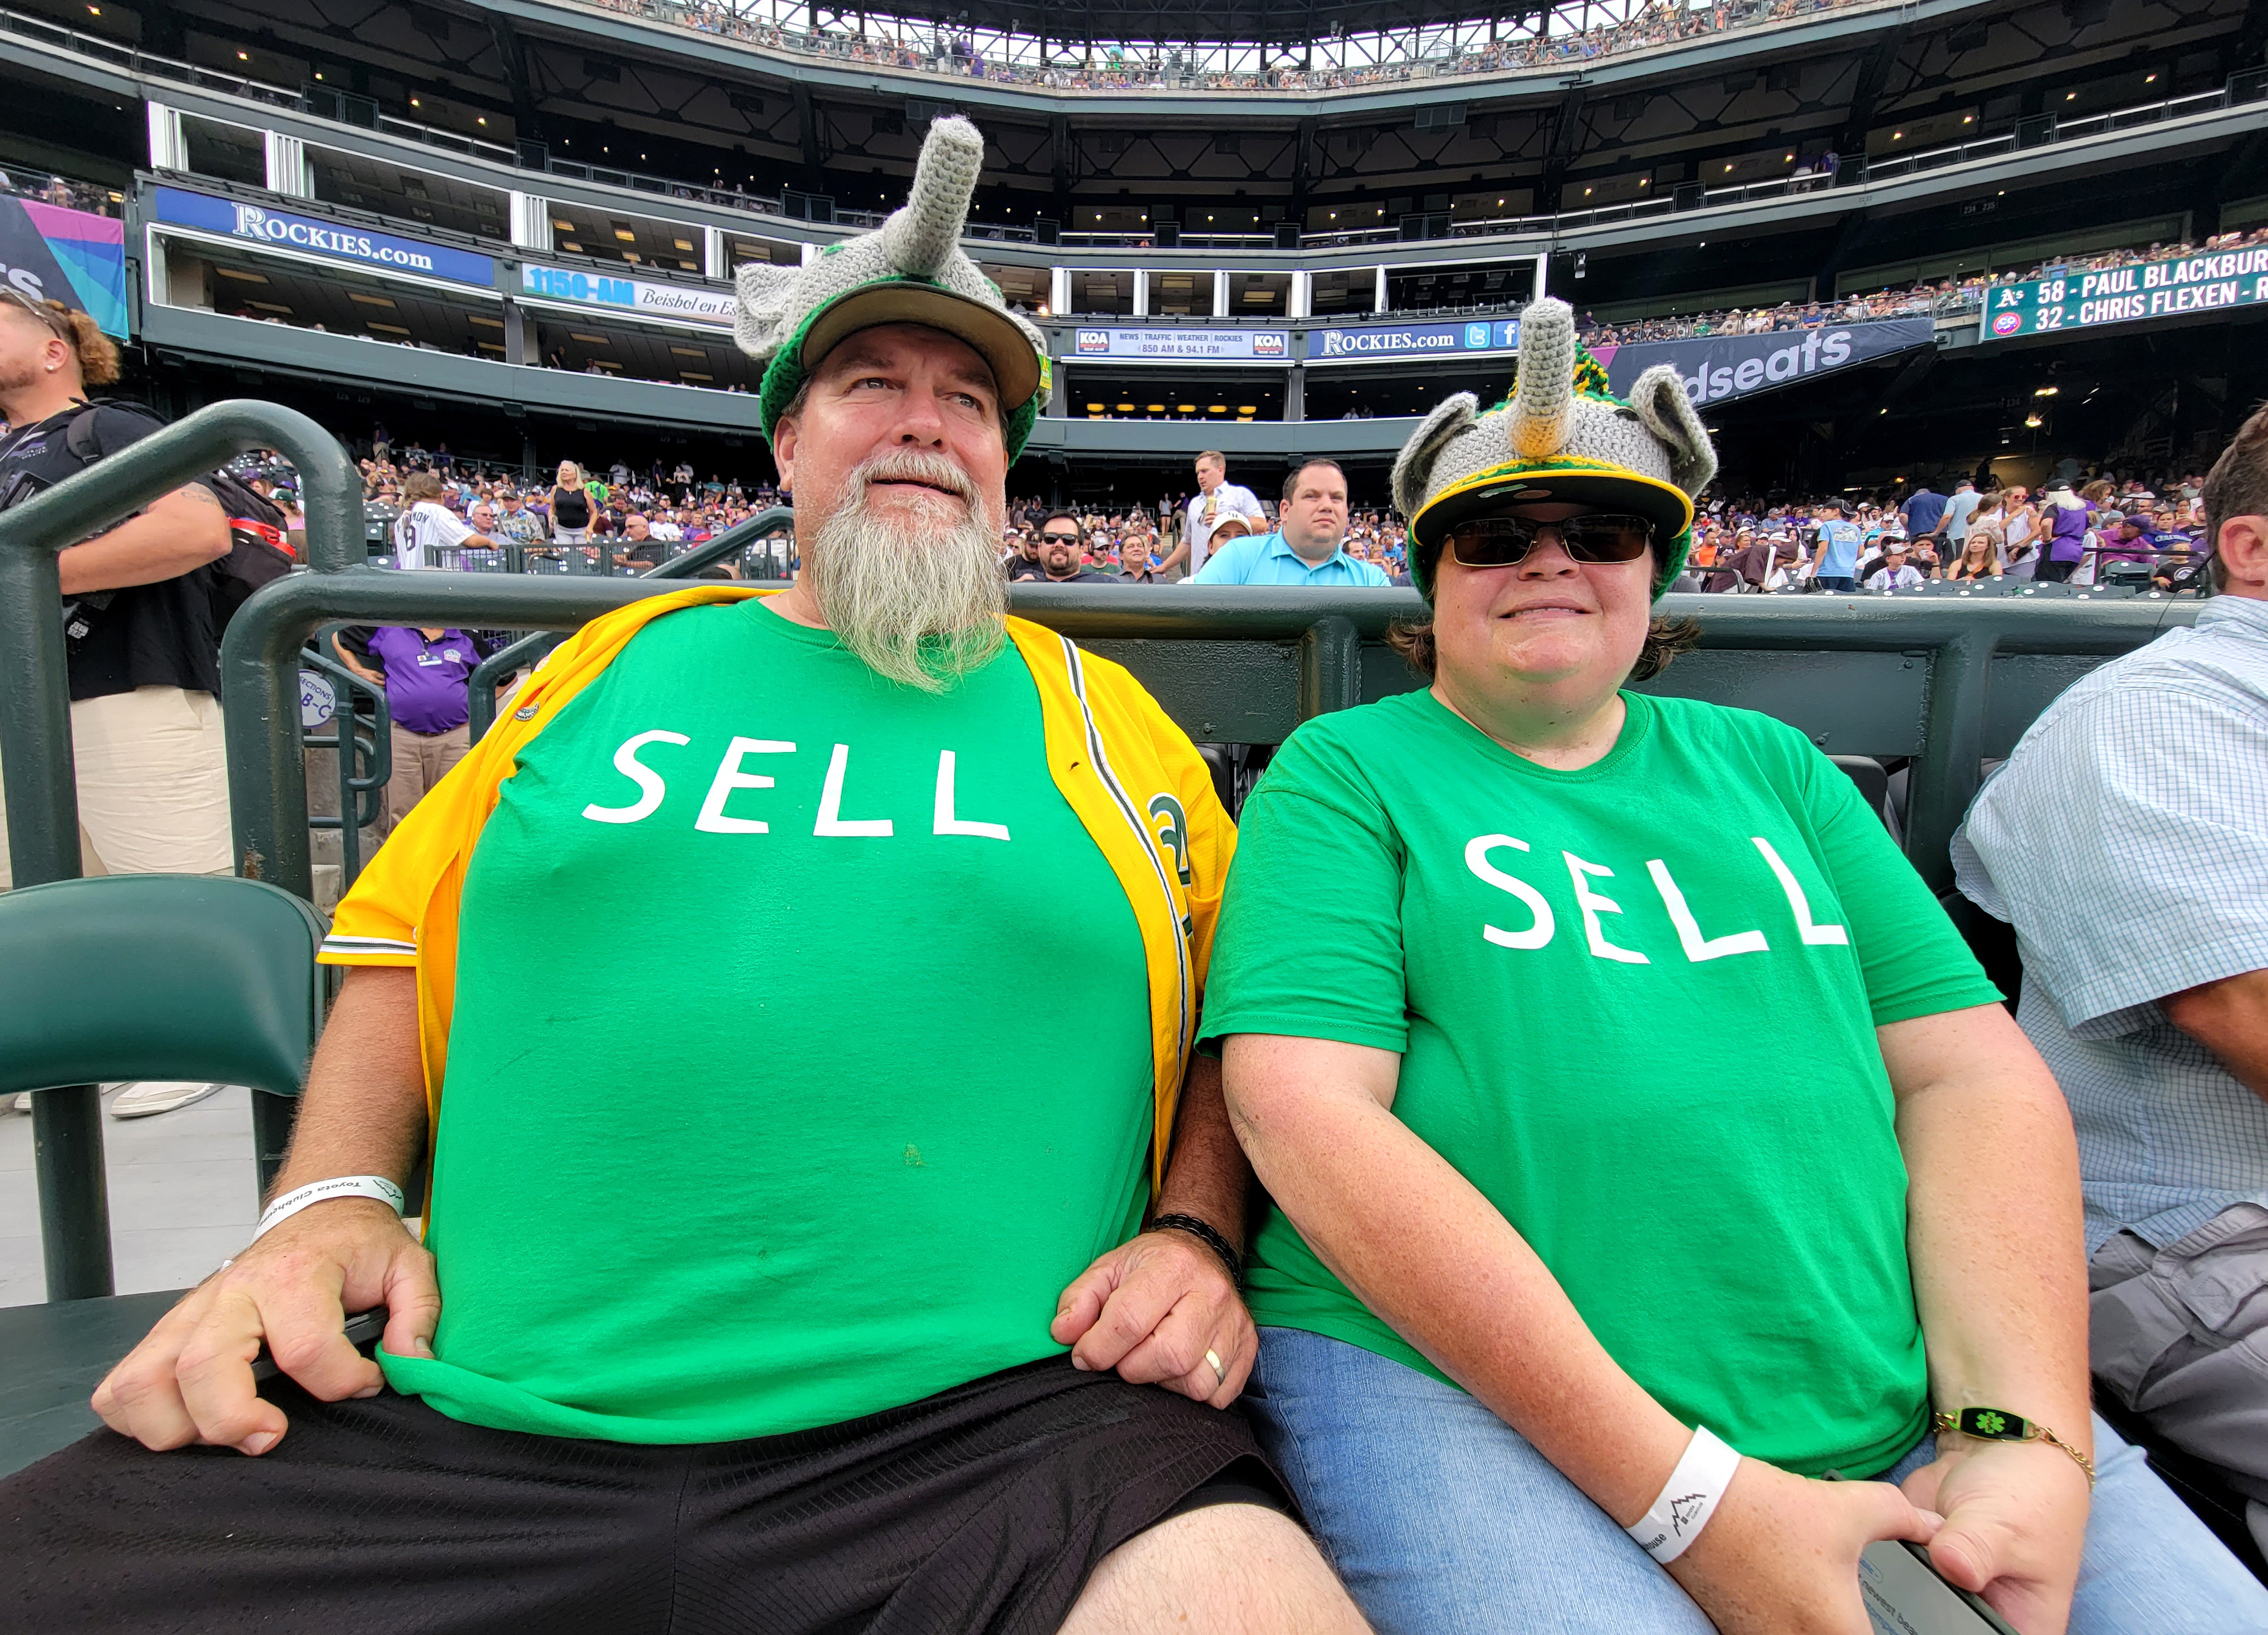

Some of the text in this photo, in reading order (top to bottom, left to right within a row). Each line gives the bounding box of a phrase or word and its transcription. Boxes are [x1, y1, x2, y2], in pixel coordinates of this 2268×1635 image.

[529, 268, 635, 306] 1150-AM
[643, 288, 699, 313] Beisbol
[699, 302, 717, 314] en
[2035, 306, 2064, 331] 32
[2079, 294, 2146, 325] CHRIS
[2150, 281, 2238, 315] FLEXEN
[2037, 280, 2066, 306] 58
[2081, 269, 2136, 299] PAUL
[1080, 332, 1108, 344] KOA
[1142, 345, 1220, 354] 850 AM & 94.1 FM
[1255, 335, 1283, 347] KOA
[581, 729, 1011, 842] SELL
[1464, 833, 1849, 965] SELL
[317, 1181, 362, 1192] Toyota
[1861, 1580, 1896, 1618] newest
